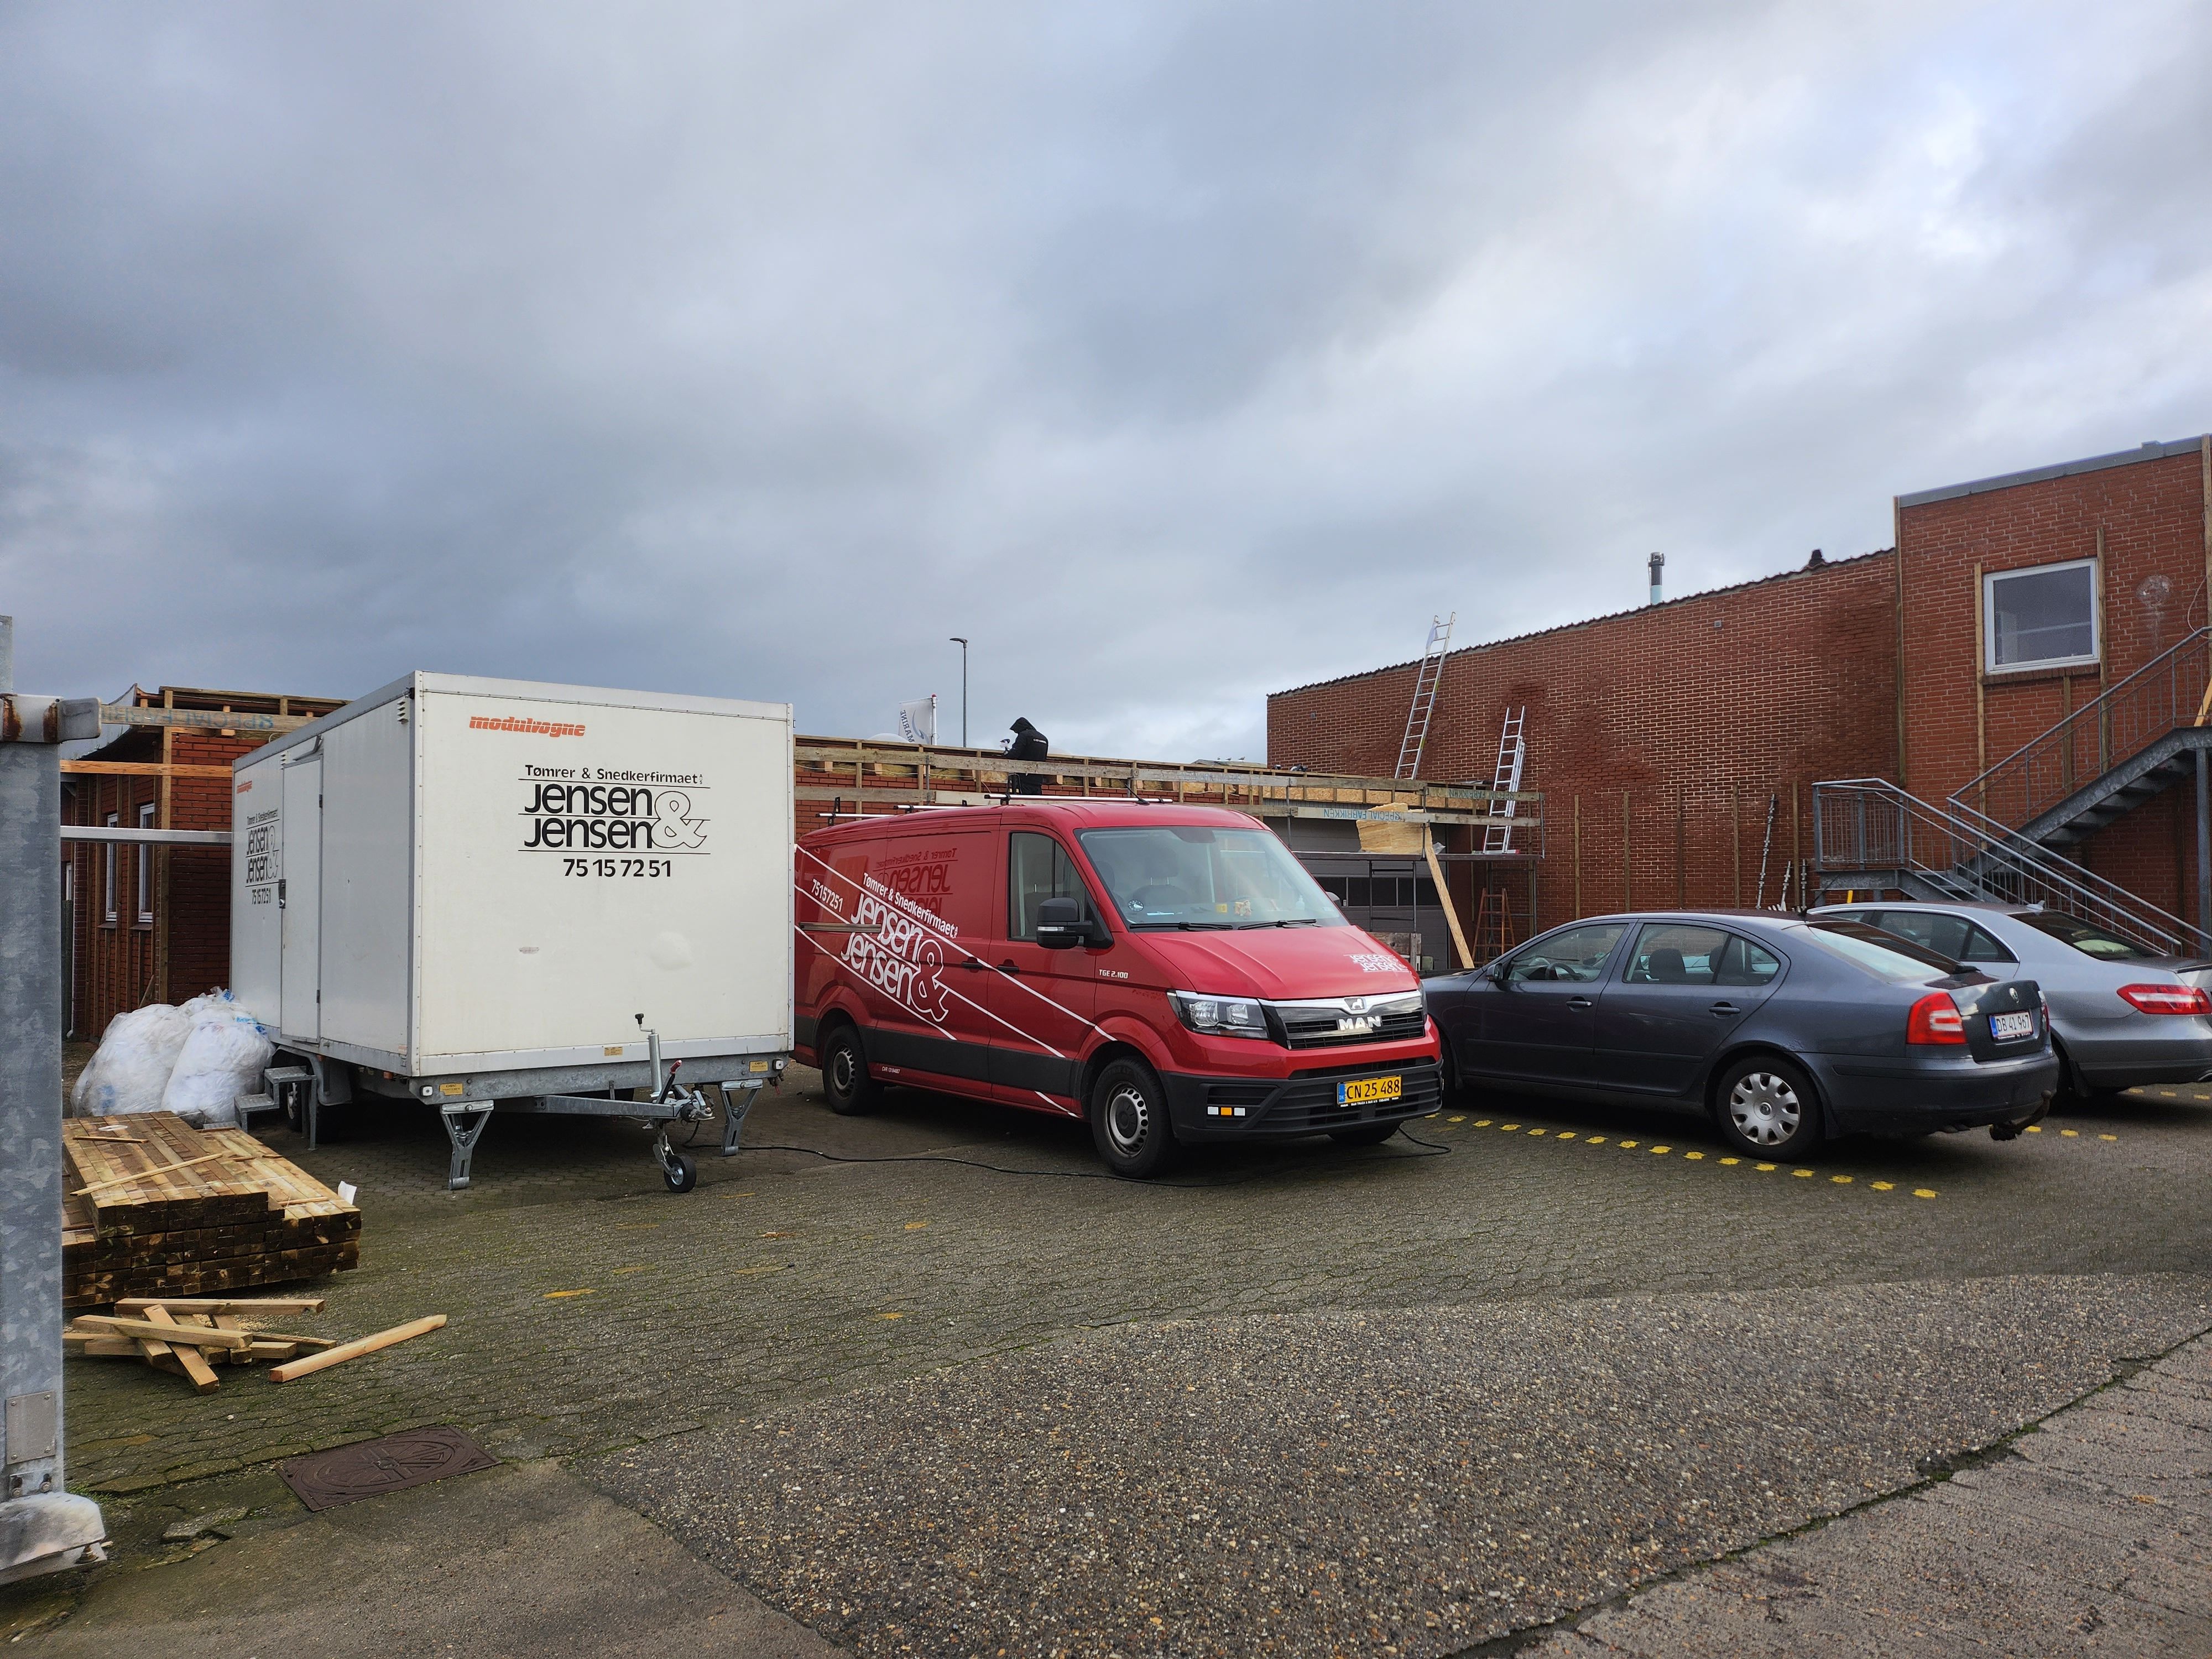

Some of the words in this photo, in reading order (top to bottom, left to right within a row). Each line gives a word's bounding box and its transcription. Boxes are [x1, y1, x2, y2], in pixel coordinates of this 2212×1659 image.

[469, 716, 586, 737] modulvogne
[525, 764, 576, 778] Tømrer
[582, 768, 591, 779] &
[597, 768, 698, 784] Snedkerfirmaet
[524, 784, 653, 816] Jensen
[1324, 808, 1367, 819] FABRIKKEN
[1370, 811, 1401, 821] SPECIAL
[524, 818, 653, 849] Jensen
[811, 878, 844, 912] 75157251
[863, 872, 889, 898] Tømrer
[888, 888, 894, 902] &
[895, 891, 955, 938] Snedkerfirmaet
[840, 932, 913, 1005] Jensen
[1099, 969, 1110, 977] TGE
[1111, 971, 1129, 979] 2.100
[1338, 1015, 1381, 1031] MAN
[1996, 1018, 2007, 1032] DB
[2009, 1017, 2017, 1030] 41
[2017, 1014, 2030, 1030] 967
[1347, 1084, 1361, 1099] CN
[1364, 1082, 1378, 1097] 25
[1380, 1079, 1400, 1094] 488
